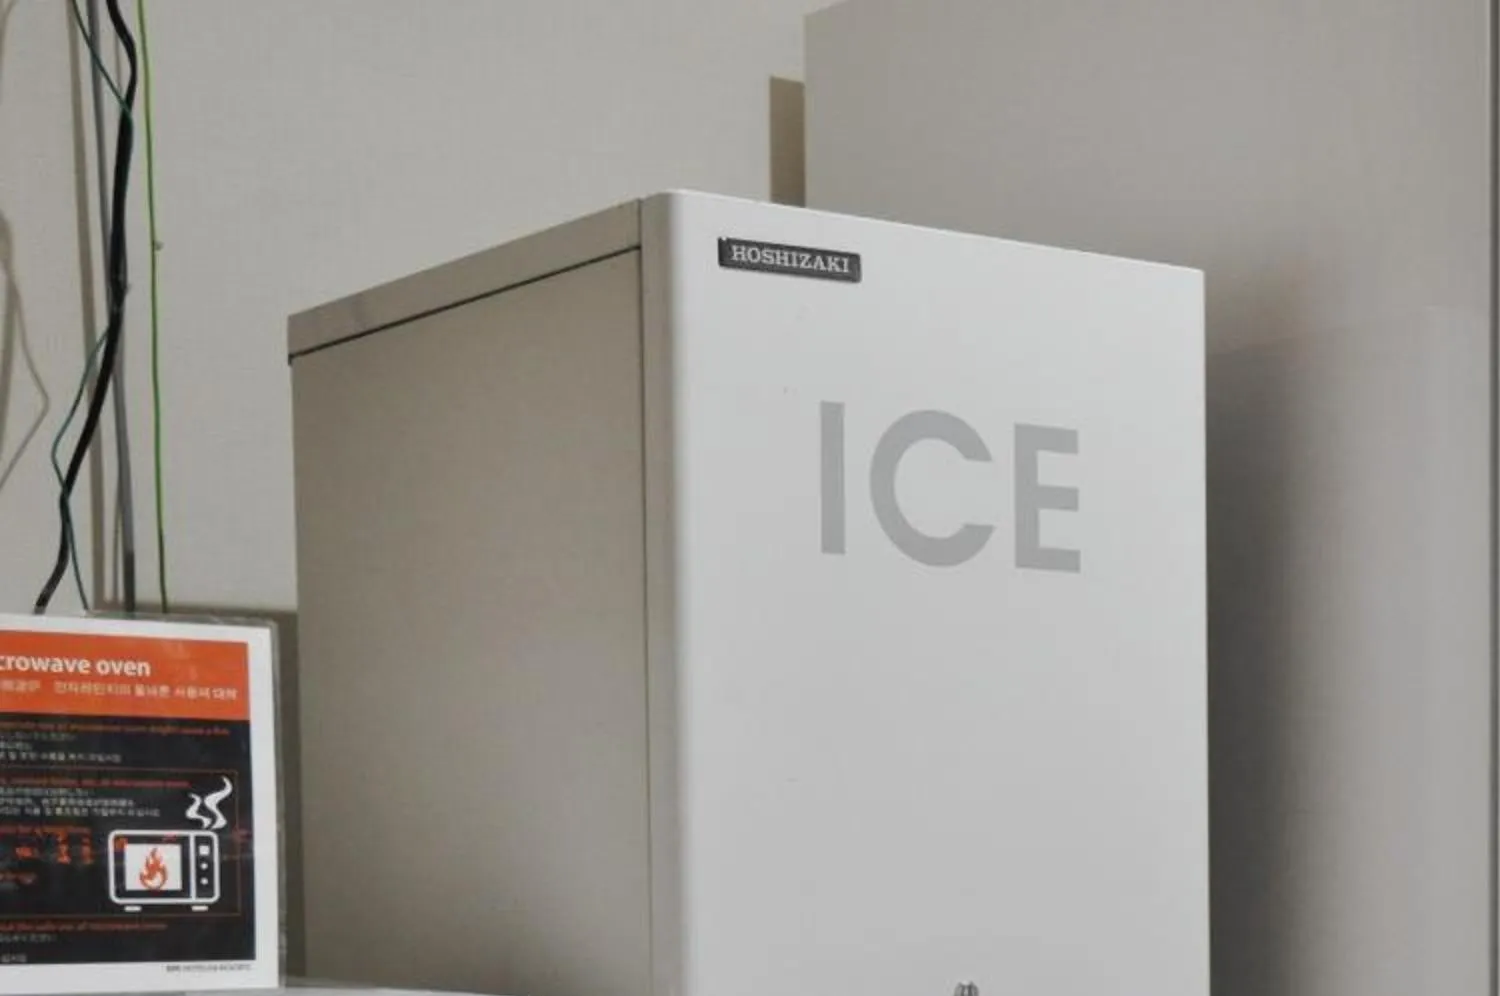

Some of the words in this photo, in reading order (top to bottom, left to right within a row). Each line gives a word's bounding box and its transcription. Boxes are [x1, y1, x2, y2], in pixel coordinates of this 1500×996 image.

[731, 244, 850, 274] HOSHIZAKI
[819, 399, 1082, 574] ICE
[97, 660, 151, 677] oven
